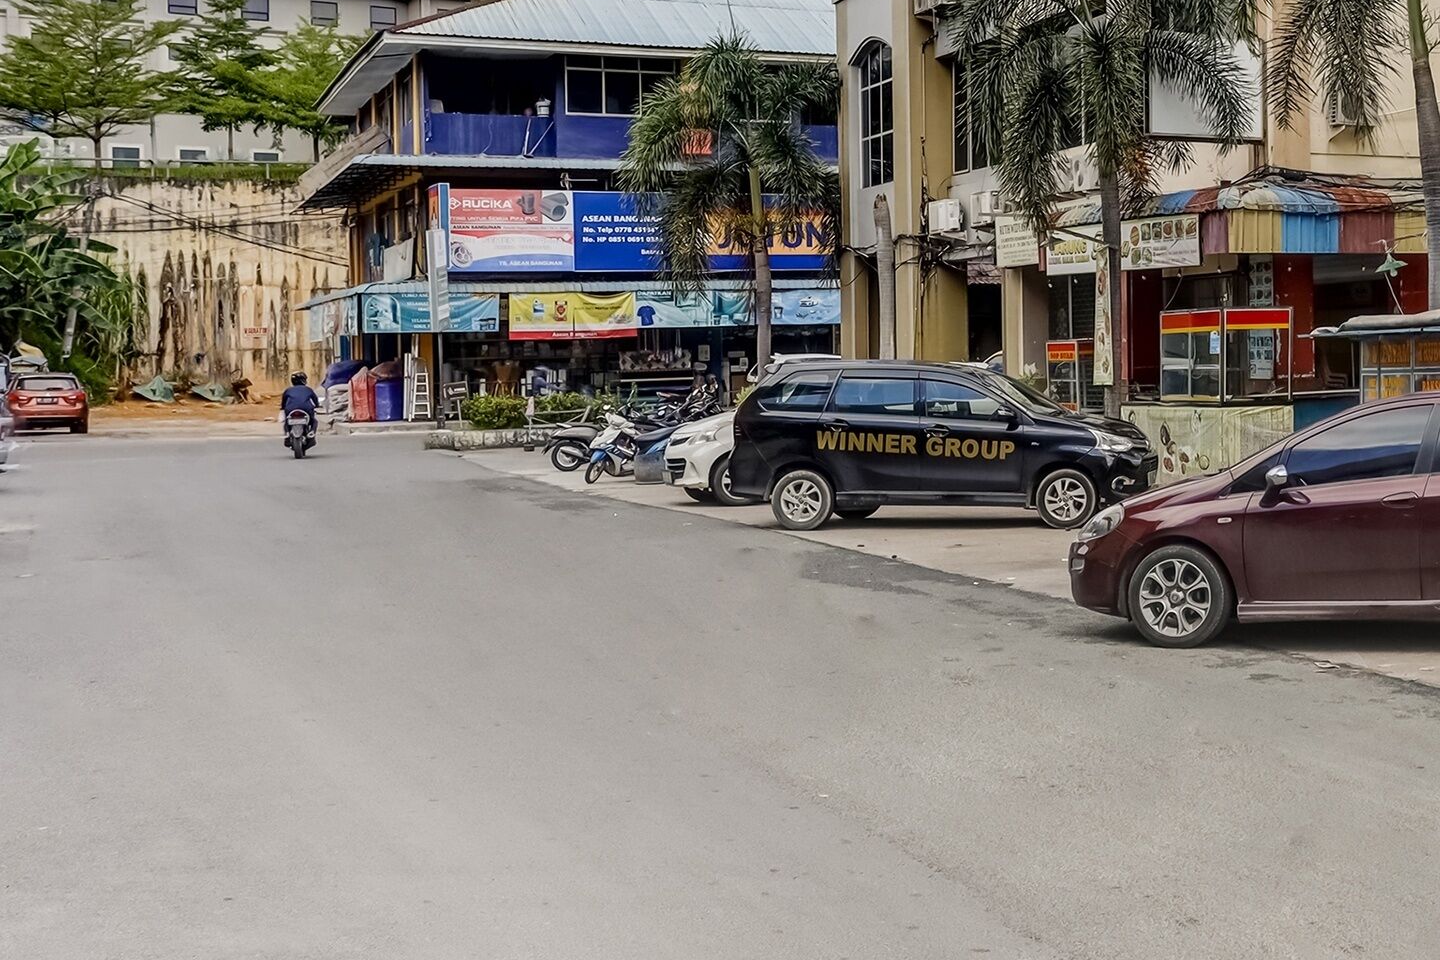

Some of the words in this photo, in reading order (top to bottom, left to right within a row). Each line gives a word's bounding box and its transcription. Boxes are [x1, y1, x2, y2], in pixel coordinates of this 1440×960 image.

[462, 199, 512, 209] RUCIKA
[582, 215, 611, 223] ASEAN
[816, 430, 917, 455] WINNER
[925, 436, 1016, 460] GROUP
